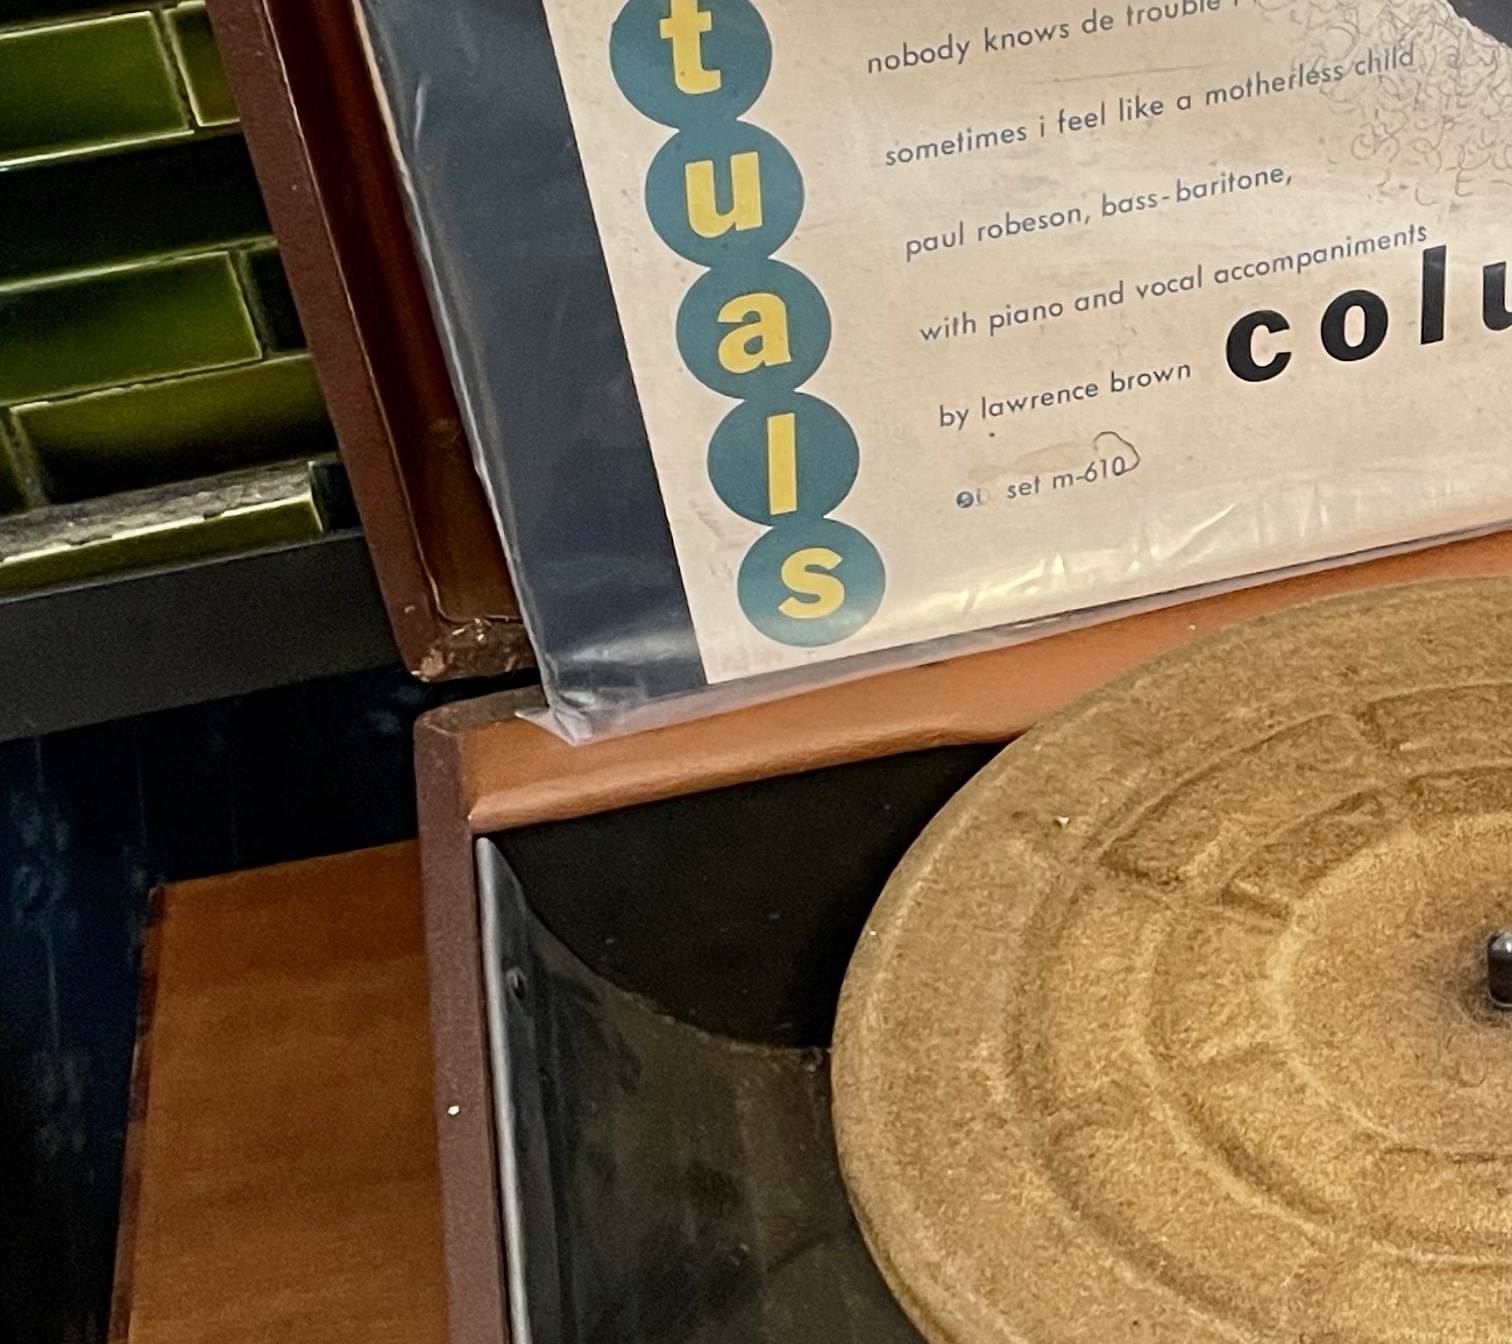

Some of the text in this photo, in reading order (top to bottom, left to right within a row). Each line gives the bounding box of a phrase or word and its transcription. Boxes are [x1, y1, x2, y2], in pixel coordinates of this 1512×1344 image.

[867, 36, 971, 75] nobody
[983, 19, 1070, 54] knows
[1081, 7, 1114, 37] de
[885, 42, 1415, 167] sometimes i feel like a motherless child
[905, 222, 965, 262] paul
[976, 207, 1091, 242] robeson,
[919, 223, 1428, 342] with piano and vocal accompaniments
[938, 362, 1192, 431] by lawrence brown
[1006, 456, 1126, 499] set m-610
